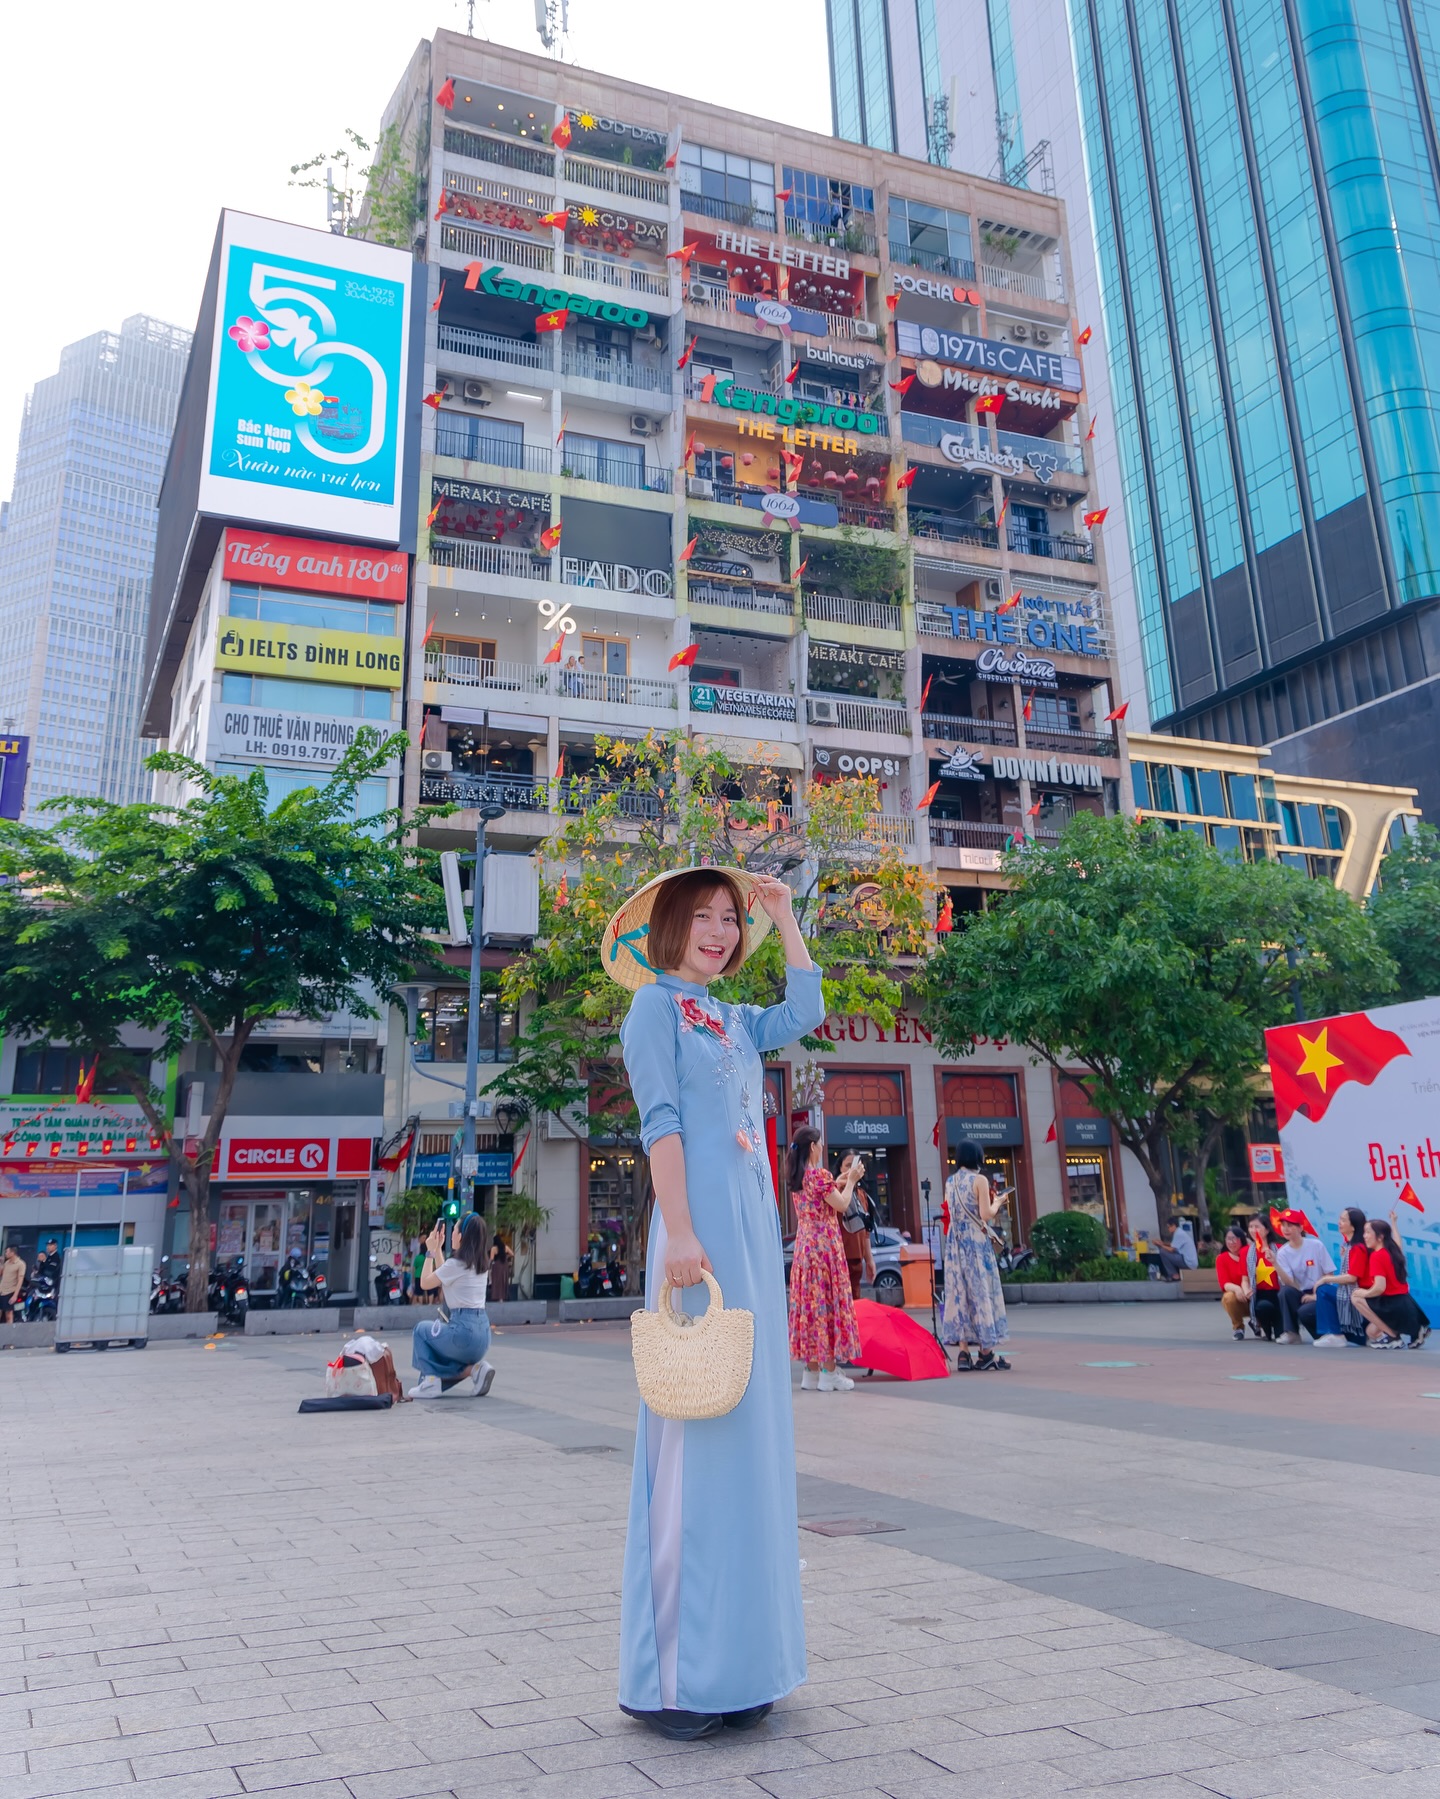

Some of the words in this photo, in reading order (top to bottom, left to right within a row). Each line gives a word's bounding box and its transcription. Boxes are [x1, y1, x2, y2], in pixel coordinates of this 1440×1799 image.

[631, 126, 667, 145] DAY
[635, 221, 666, 239] DAY
[716, 229, 761, 259] THE
[768, 241, 849, 280] LETTER
[760, 305, 787, 320] 1664
[806, 339, 865, 370] buihaus
[940, 333, 996, 367] 1971's
[999, 348, 1062, 381] CAFE
[943, 368, 999, 396] Michi
[1005, 380, 1061, 410] Sushi
[237, 418, 262, 434] Bác
[264, 424, 292, 440] Nam
[736, 417, 775, 440] THE
[783, 427, 857, 456] LETTER
[236, 433, 264, 448] sum
[266, 438, 291, 454] họp
[940, 432, 1024, 474] Carlsberg
[221, 448, 280, 472] Xuân
[283, 466, 317, 480] nào
[321, 473, 349, 486] vui
[433, 480, 501, 505] MERAKI
[508, 493, 551, 512] CAFÉ
[766, 498, 795, 513] 1664
[228, 542, 291, 576] Tiếng
[296, 555, 343, 578] anh
[347, 558, 389, 583] 180
[390, 563, 404, 575] độ
[562, 557, 672, 598] FADO
[1023, 594, 1050, 614] NỘI
[1053, 600, 1092, 618] THẤT
[943, 606, 1017, 644] THE
[1027, 619, 1101, 655] ONE
[249, 638, 298, 660] IELTS
[305, 643, 348, 666] ĐÌNH
[356, 650, 400, 671] LONG
[808, 646, 864, 665] MERAKI
[697, 688, 710, 700] 21
[1042, 681, 1059, 689] WINE
[717, 688, 795, 708] VEGETARIAN
[718, 702, 766, 715] VIETNAMESE
[767, 708, 795, 720] COFFEE
[224, 712, 249, 735] CHO
[253, 713, 282, 738] THUÊ
[287, 715, 312, 741] VĂN
[314, 718, 354, 745] PHÒNG
[245, 740, 267, 754] LH:
[837, 755, 899, 776] OOPS!
[992, 756, 1102, 787] DOWNTOWN
[422, 781, 498, 801] MERAKI
[64, 1115, 89, 1127] QUẢN
[853, 1120, 889, 1134] fahasa
[13, 1131, 41, 1142] CÔNG
[44, 1130, 63, 1142] VIÊN
[66, 1130, 86, 1142] TRÊN
[234, 1146, 295, 1165] CIRCLE
[1368, 1143, 1410, 1188] Đại
